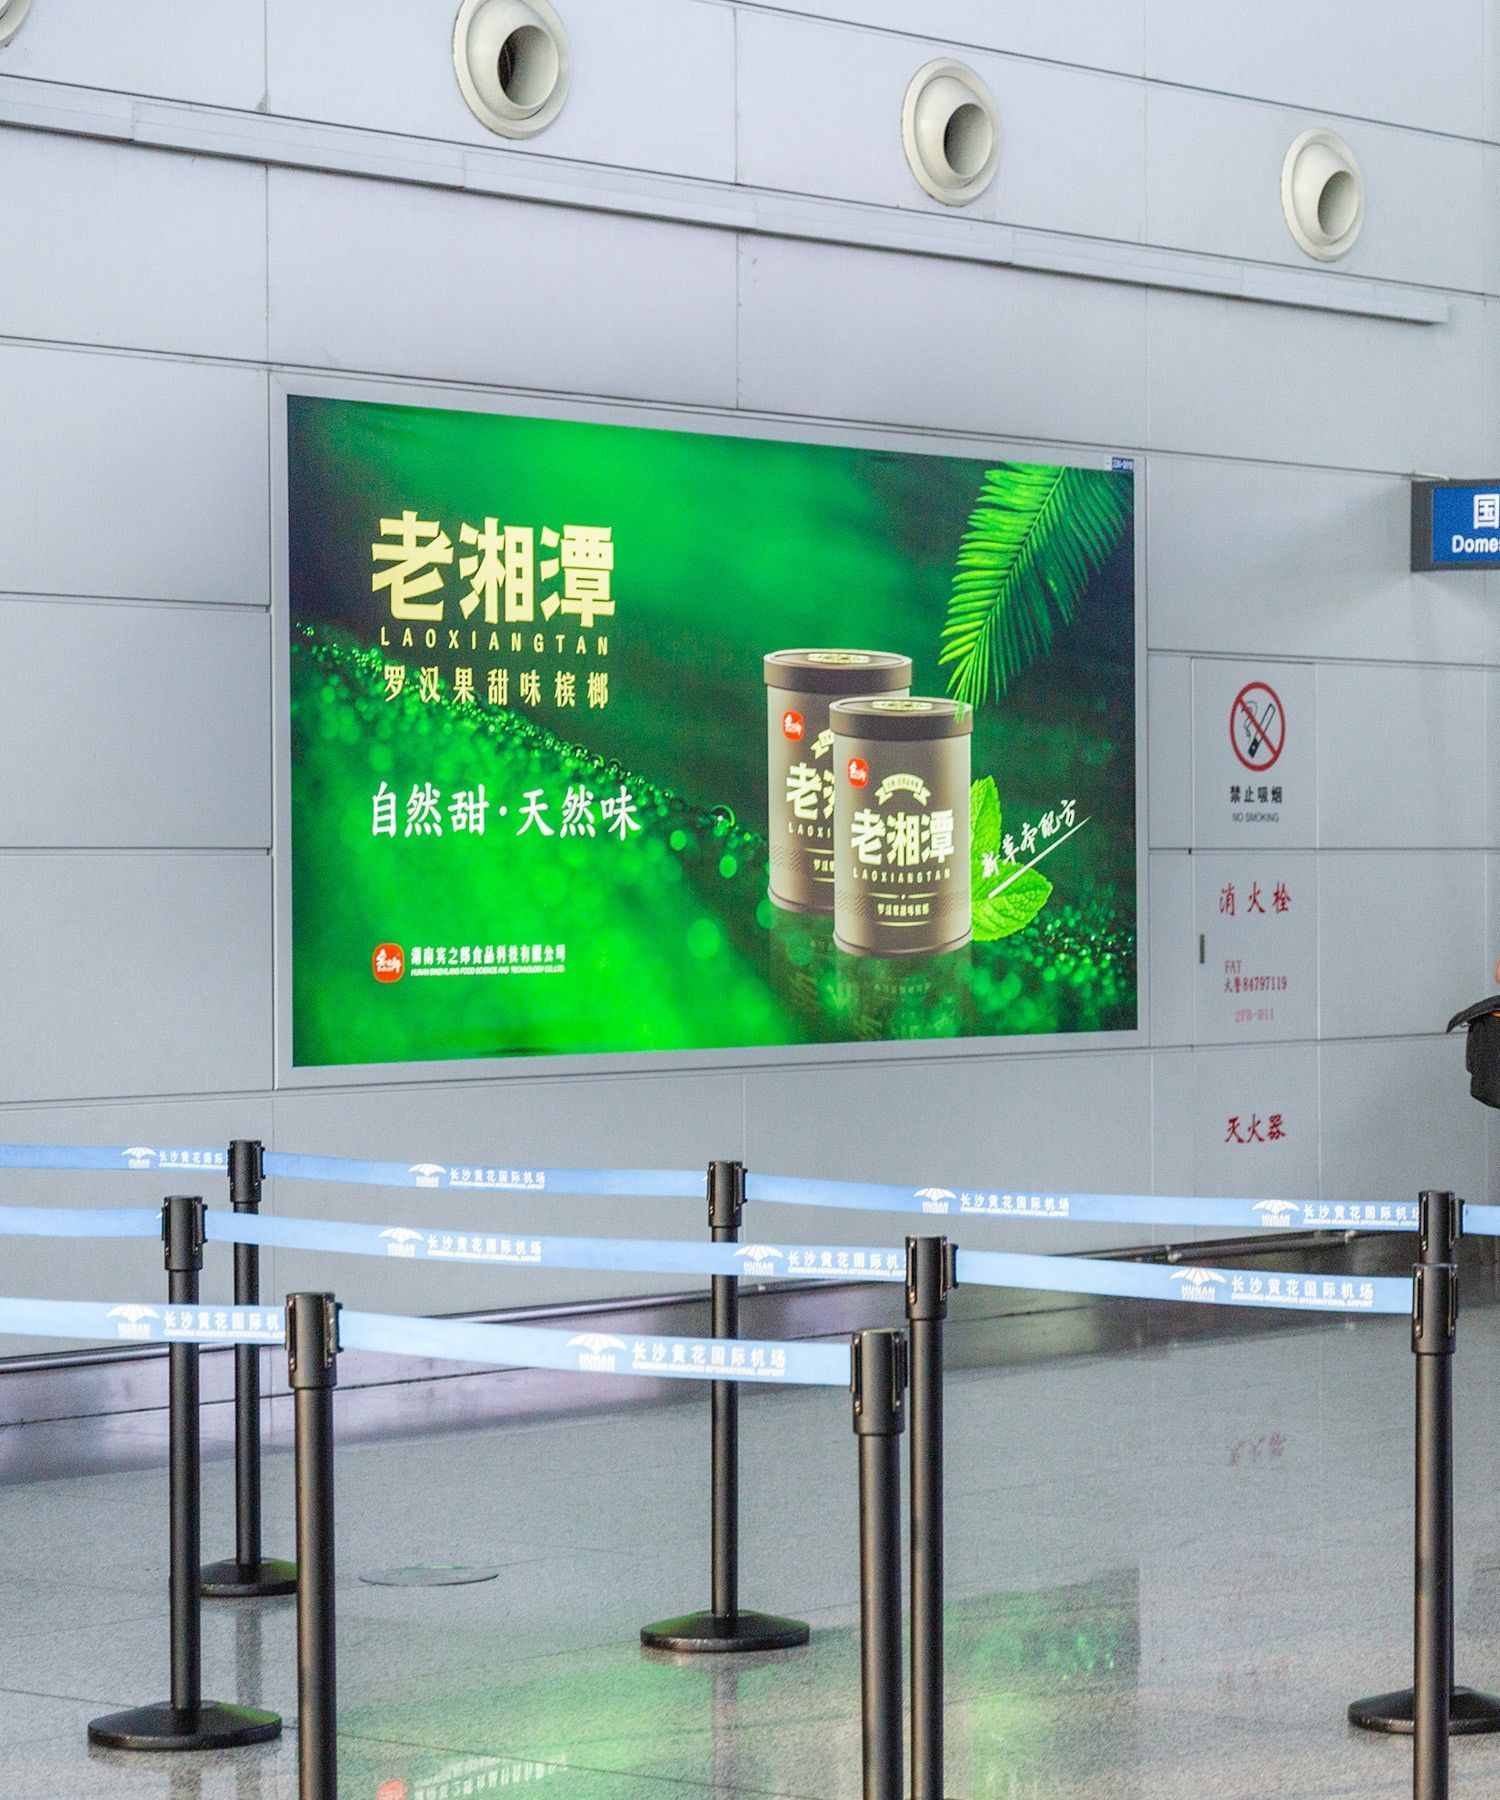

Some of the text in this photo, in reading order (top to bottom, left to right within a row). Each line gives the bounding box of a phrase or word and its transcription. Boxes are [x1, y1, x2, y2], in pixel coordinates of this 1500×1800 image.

[372, 510, 616, 627] 老湘潭
[380, 626, 608, 656] LAOXIANGTAN
[383, 664, 609, 709] 罗汉果甜味槟榔
[1230, 785, 1283, 804] 禁止吸烟
[1232, 812, 1280, 823] NO SMOKING
[851, 808, 954, 866] 老湘潭
[853, 867, 951, 884] LAOXIANGTAN
[1218, 881, 1292, 917] 消火栓
[1225, 1113, 1286, 1144] 灭火器
[159, 1149, 228, 1164] 长沙黄花国际
[788, 1250, 906, 1270] 长沙黄花国际机
[1231, 1275, 1374, 1301] 长沙黄花国际机场
[632, 1341, 786, 1369] 长沙黄花国际机场
